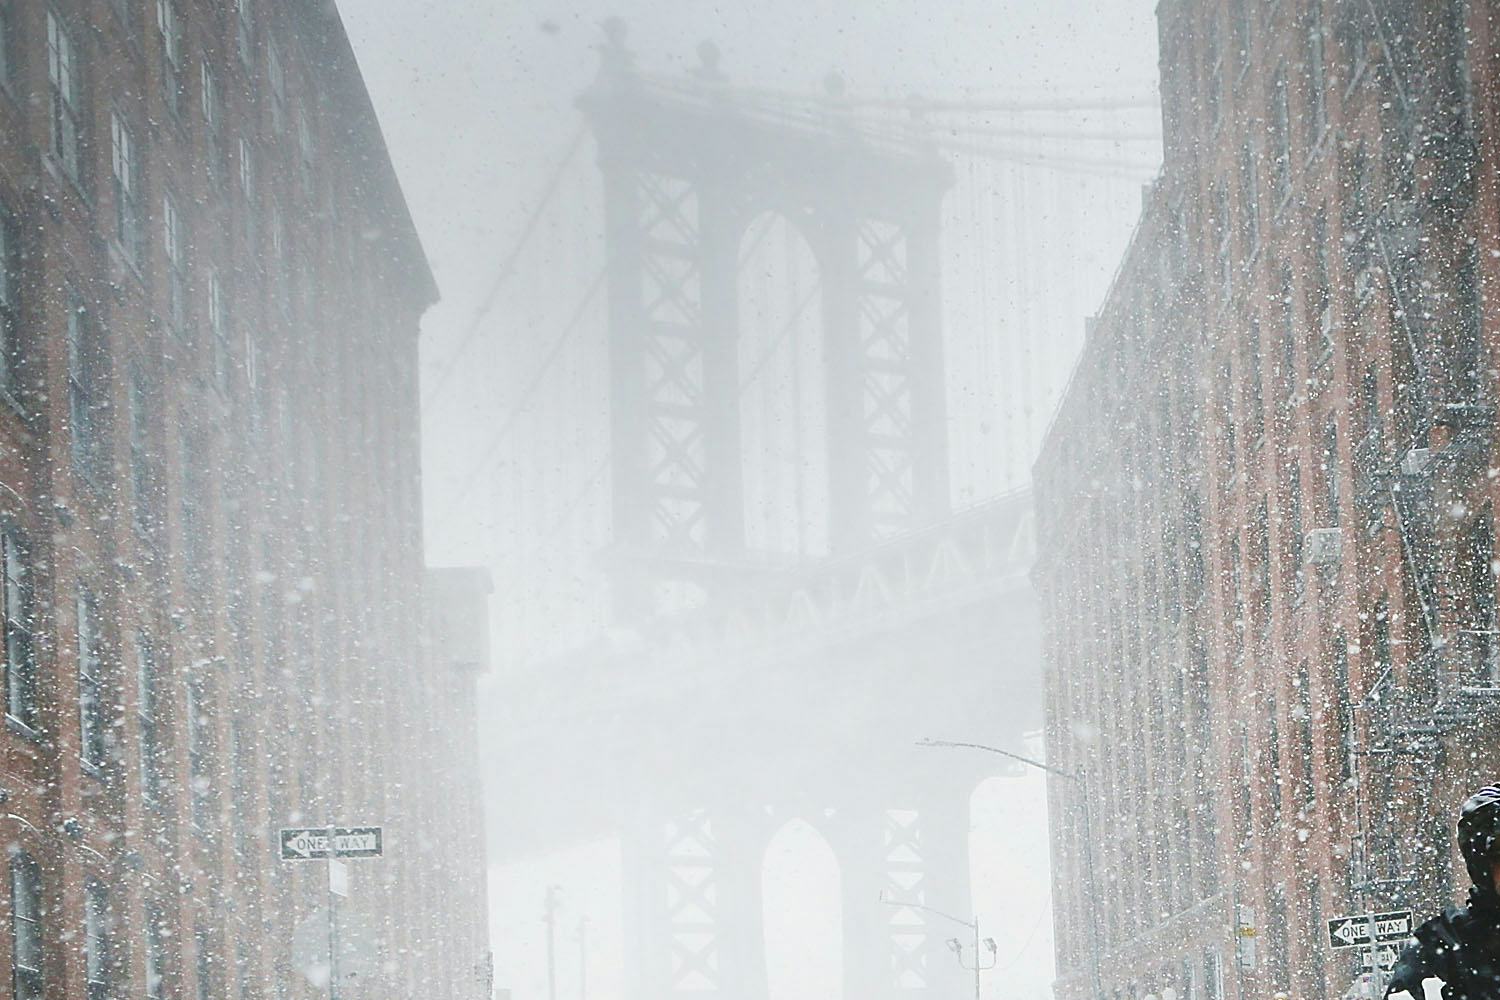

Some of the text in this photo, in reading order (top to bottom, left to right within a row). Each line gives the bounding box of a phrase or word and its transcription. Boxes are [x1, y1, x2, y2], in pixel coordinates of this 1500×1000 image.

[297, 837, 368, 851] ONE WAY
[1342, 921, 1402, 938] ONE WAY
